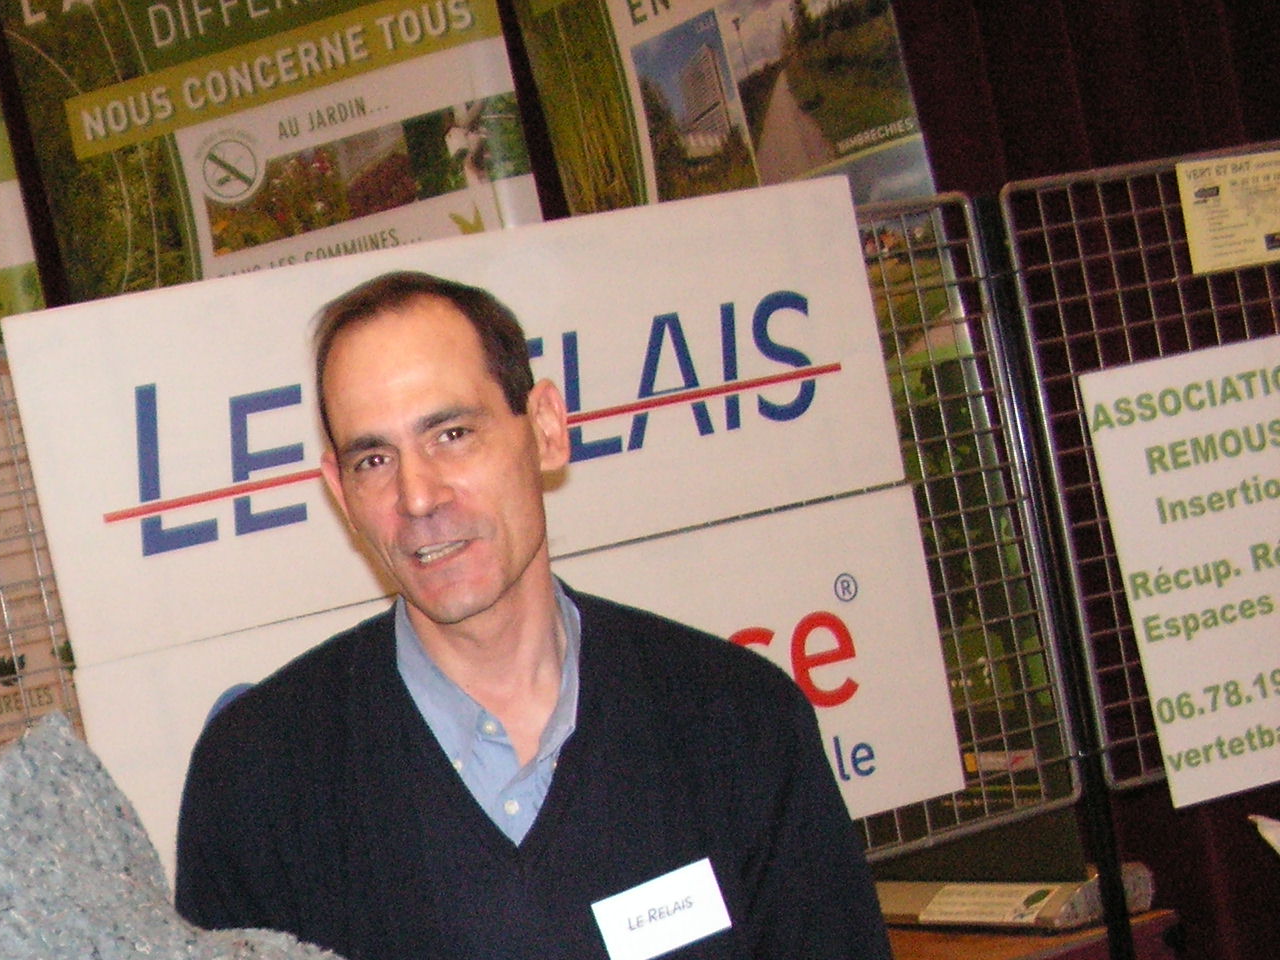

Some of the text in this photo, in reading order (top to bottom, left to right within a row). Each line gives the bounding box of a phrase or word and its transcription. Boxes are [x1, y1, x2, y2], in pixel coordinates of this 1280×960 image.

[81, 86, 174, 141] NOUS
[182, 24, 368, 112] CONCERNE
[376, 0, 475, 50] TOUS
[277, 116, 300, 140] AU
[134, 383, 308, 557] LE
[1129, 558, 1242, 600] Récup.
[1143, 594, 1274, 643] Espaces
[627, 896, 694, 931] LE RELAIS
